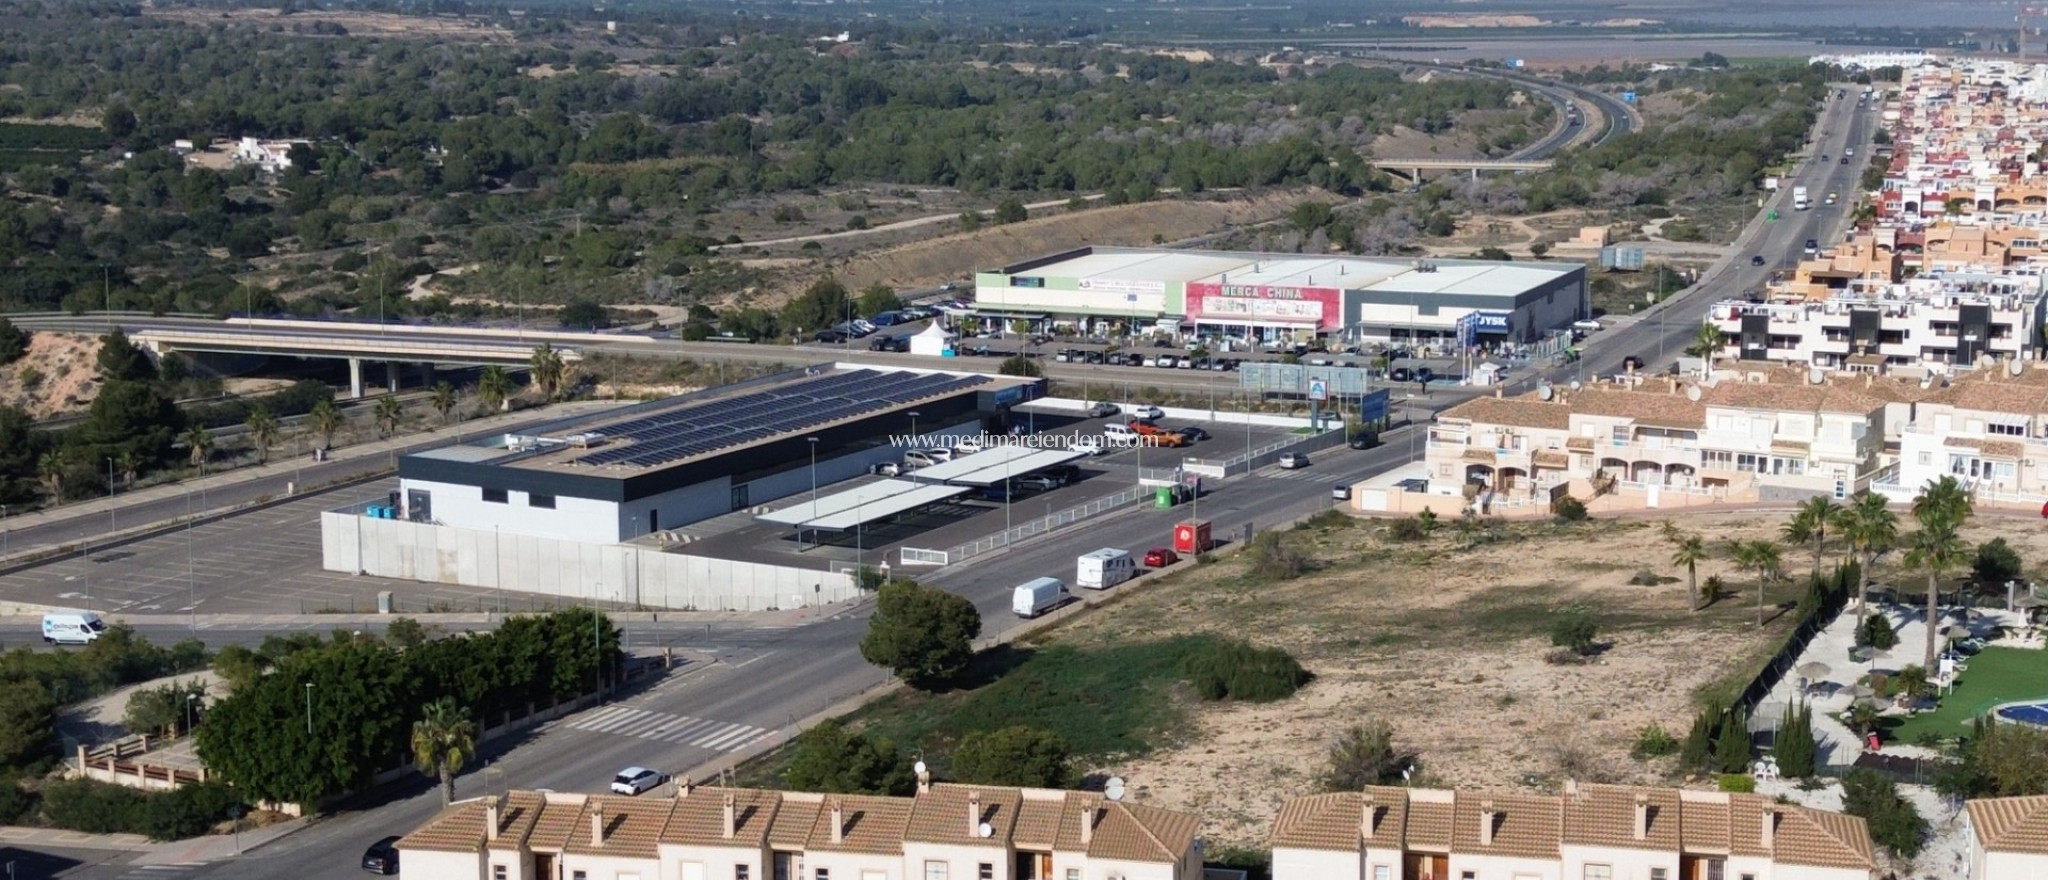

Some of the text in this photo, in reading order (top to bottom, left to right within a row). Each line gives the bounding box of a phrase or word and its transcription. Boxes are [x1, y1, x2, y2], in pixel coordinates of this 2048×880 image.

[1221, 285, 1303, 299] MERCA CHINA
[1479, 316, 1507, 326] JYSK
